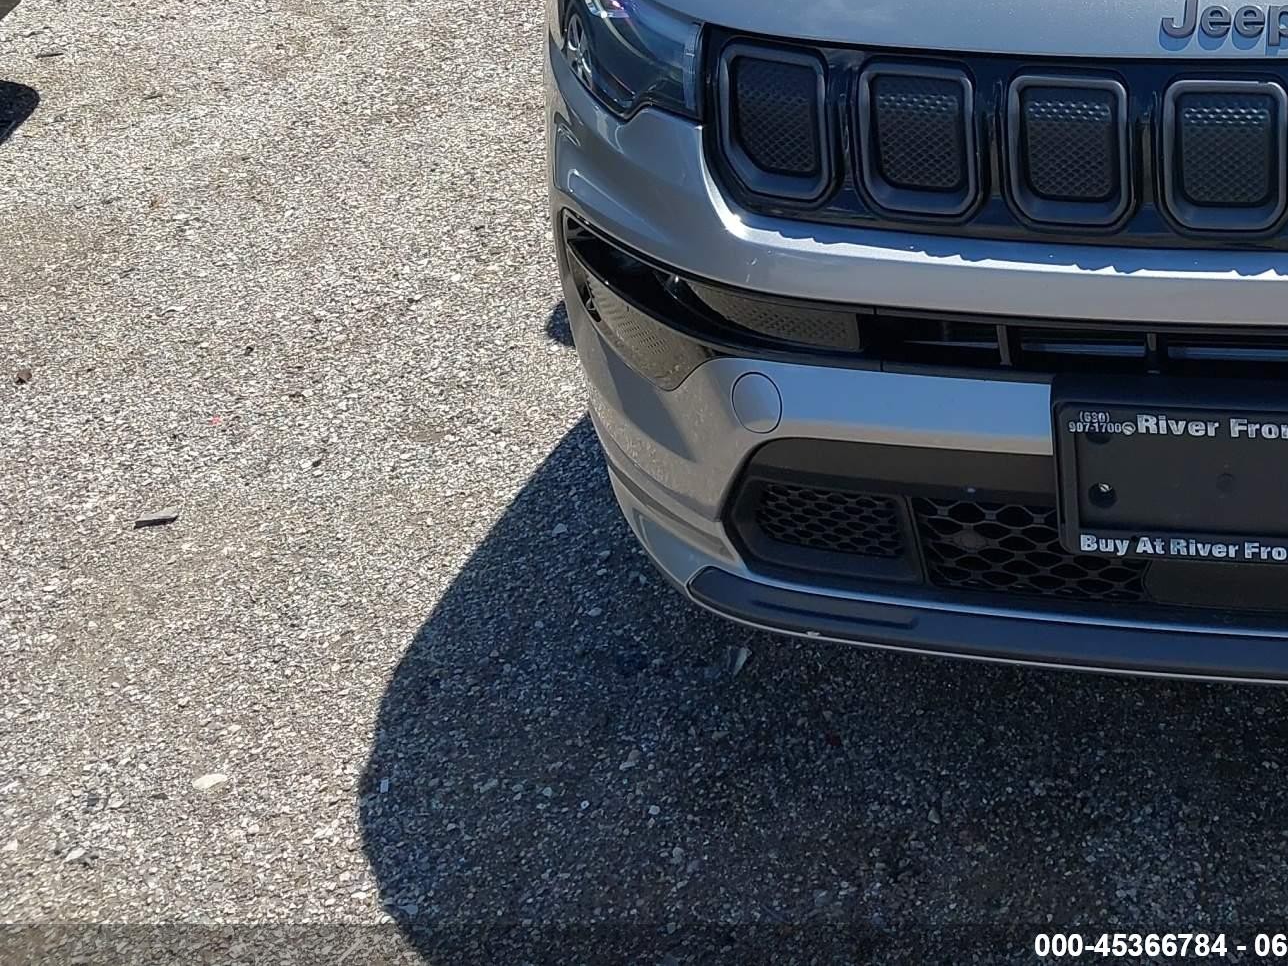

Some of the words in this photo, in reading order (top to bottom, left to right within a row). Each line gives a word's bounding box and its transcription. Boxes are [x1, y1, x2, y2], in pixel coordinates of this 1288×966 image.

[1069, 421, 1122, 433] 907-1700
[1136, 414, 1220, 437] River
[1080, 535, 1130, 556] Buy
[1135, 537, 1165, 554] At
[1170, 538, 1239, 558] River
